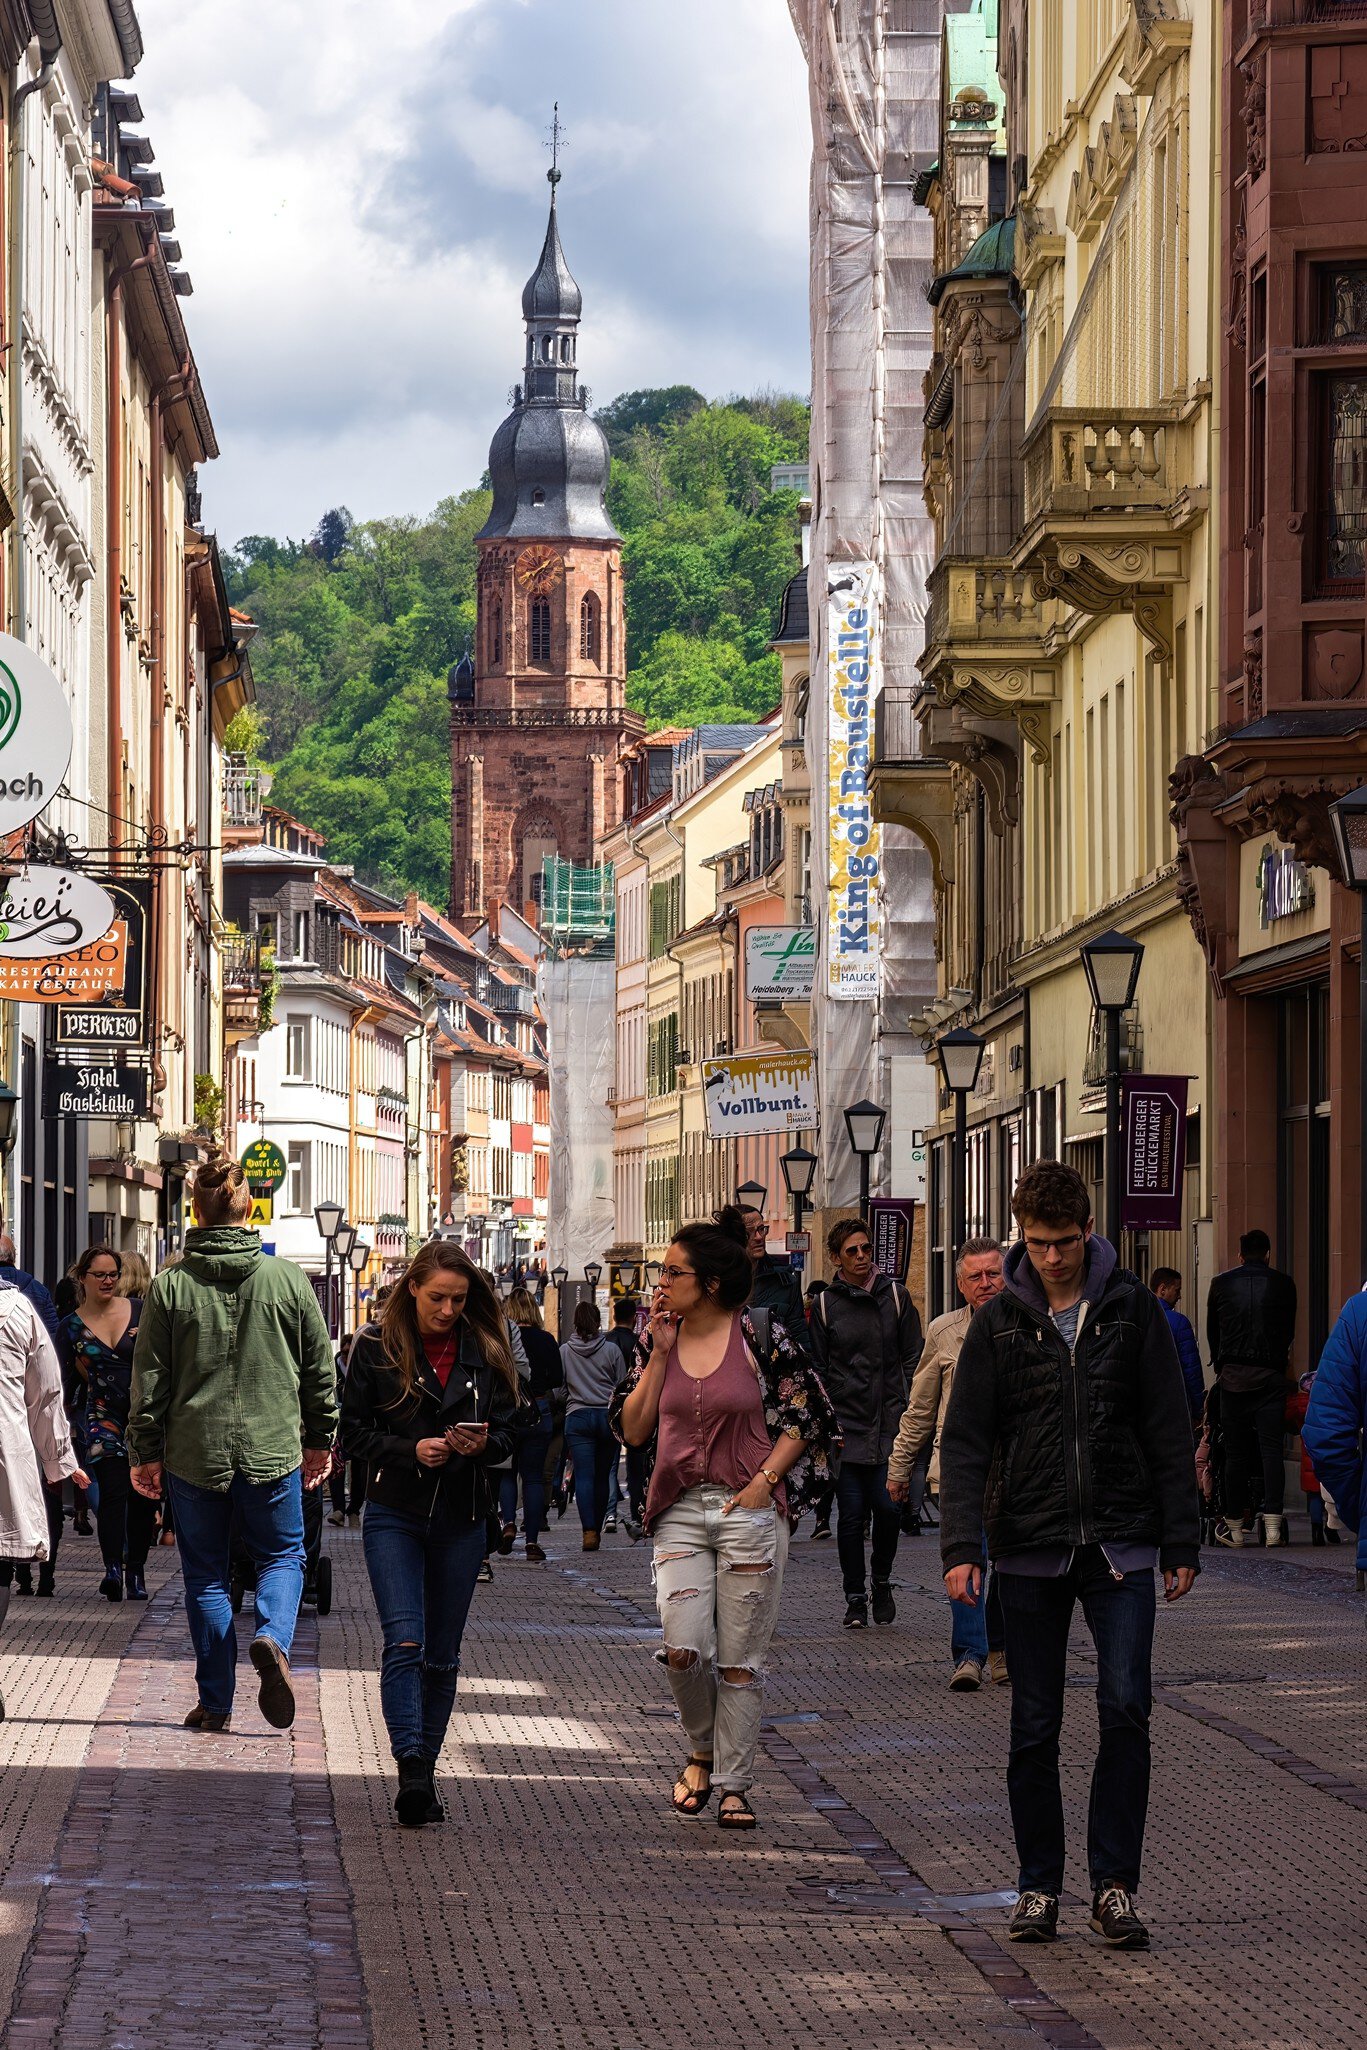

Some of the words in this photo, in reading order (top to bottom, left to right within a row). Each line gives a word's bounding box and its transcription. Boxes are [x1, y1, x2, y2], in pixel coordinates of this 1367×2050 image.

[838, 608, 869, 796] Baustelle
[838, 804, 869, 846] of
[839, 855, 878, 954] King
[841, 963, 874, 972] MALER
[841, 973, 876, 981] HAUCK
[751, 985, 794, 995] Heidelberg
[64, 1013, 137, 1037] PERKEO
[759, 1058, 807, 1069] malerhauck.de
[76, 1067, 120, 1090] Hotel
[60, 1092, 134, 1114] Gaststätte
[718, 1094, 807, 1117] Vollbunt.
[1134, 1099, 1148, 1188] HEIDELBERGER
[1145, 1100, 1162, 1188] STÜCKEMARKT
[246, 1158, 270, 1169] Hotel
[878, 1214, 888, 1274] HEIDELBERGER
[886, 1214, 898, 1274] STÜCKEMARKT
